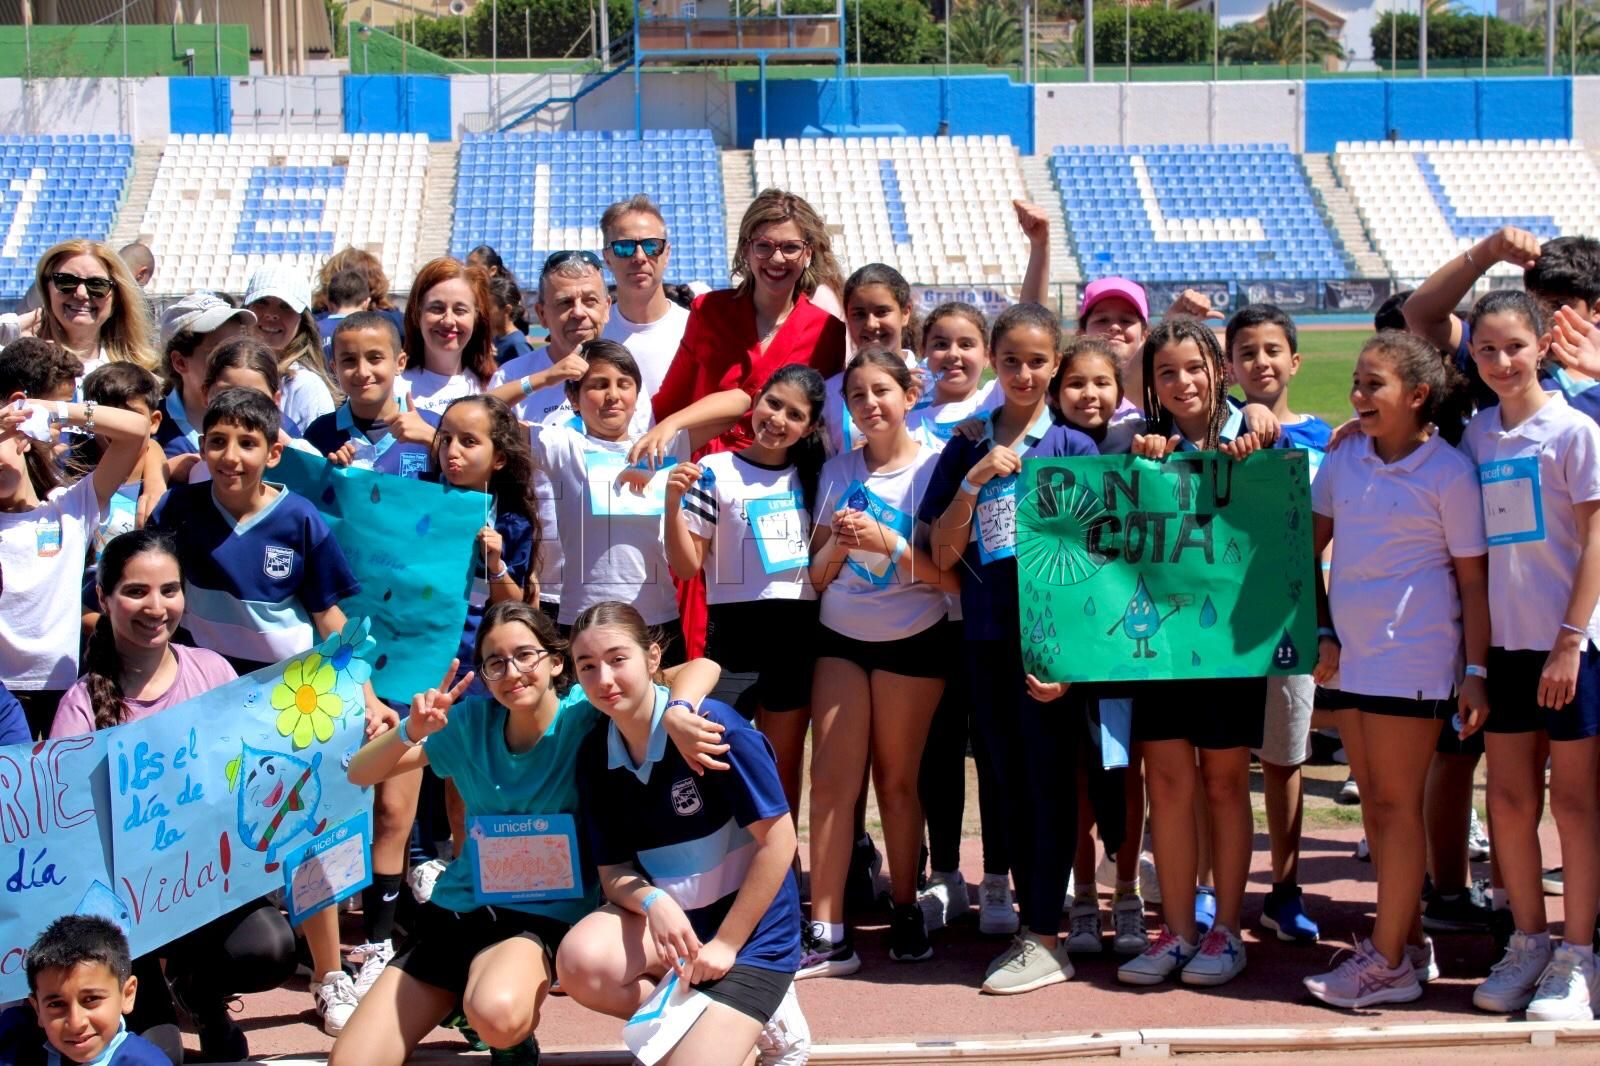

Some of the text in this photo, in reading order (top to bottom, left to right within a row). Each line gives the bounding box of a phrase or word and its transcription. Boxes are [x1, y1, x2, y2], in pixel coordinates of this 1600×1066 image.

[1160, 458, 1233, 509] TU
[173, 727, 199, 769] el
[123, 774, 206, 833] día de
[151, 824, 187, 851] la
[304, 831, 336, 857] unicef
[494, 819, 533, 833] unicef
[6, 847, 68, 893] día
[121, 831, 232, 926] Vida!
